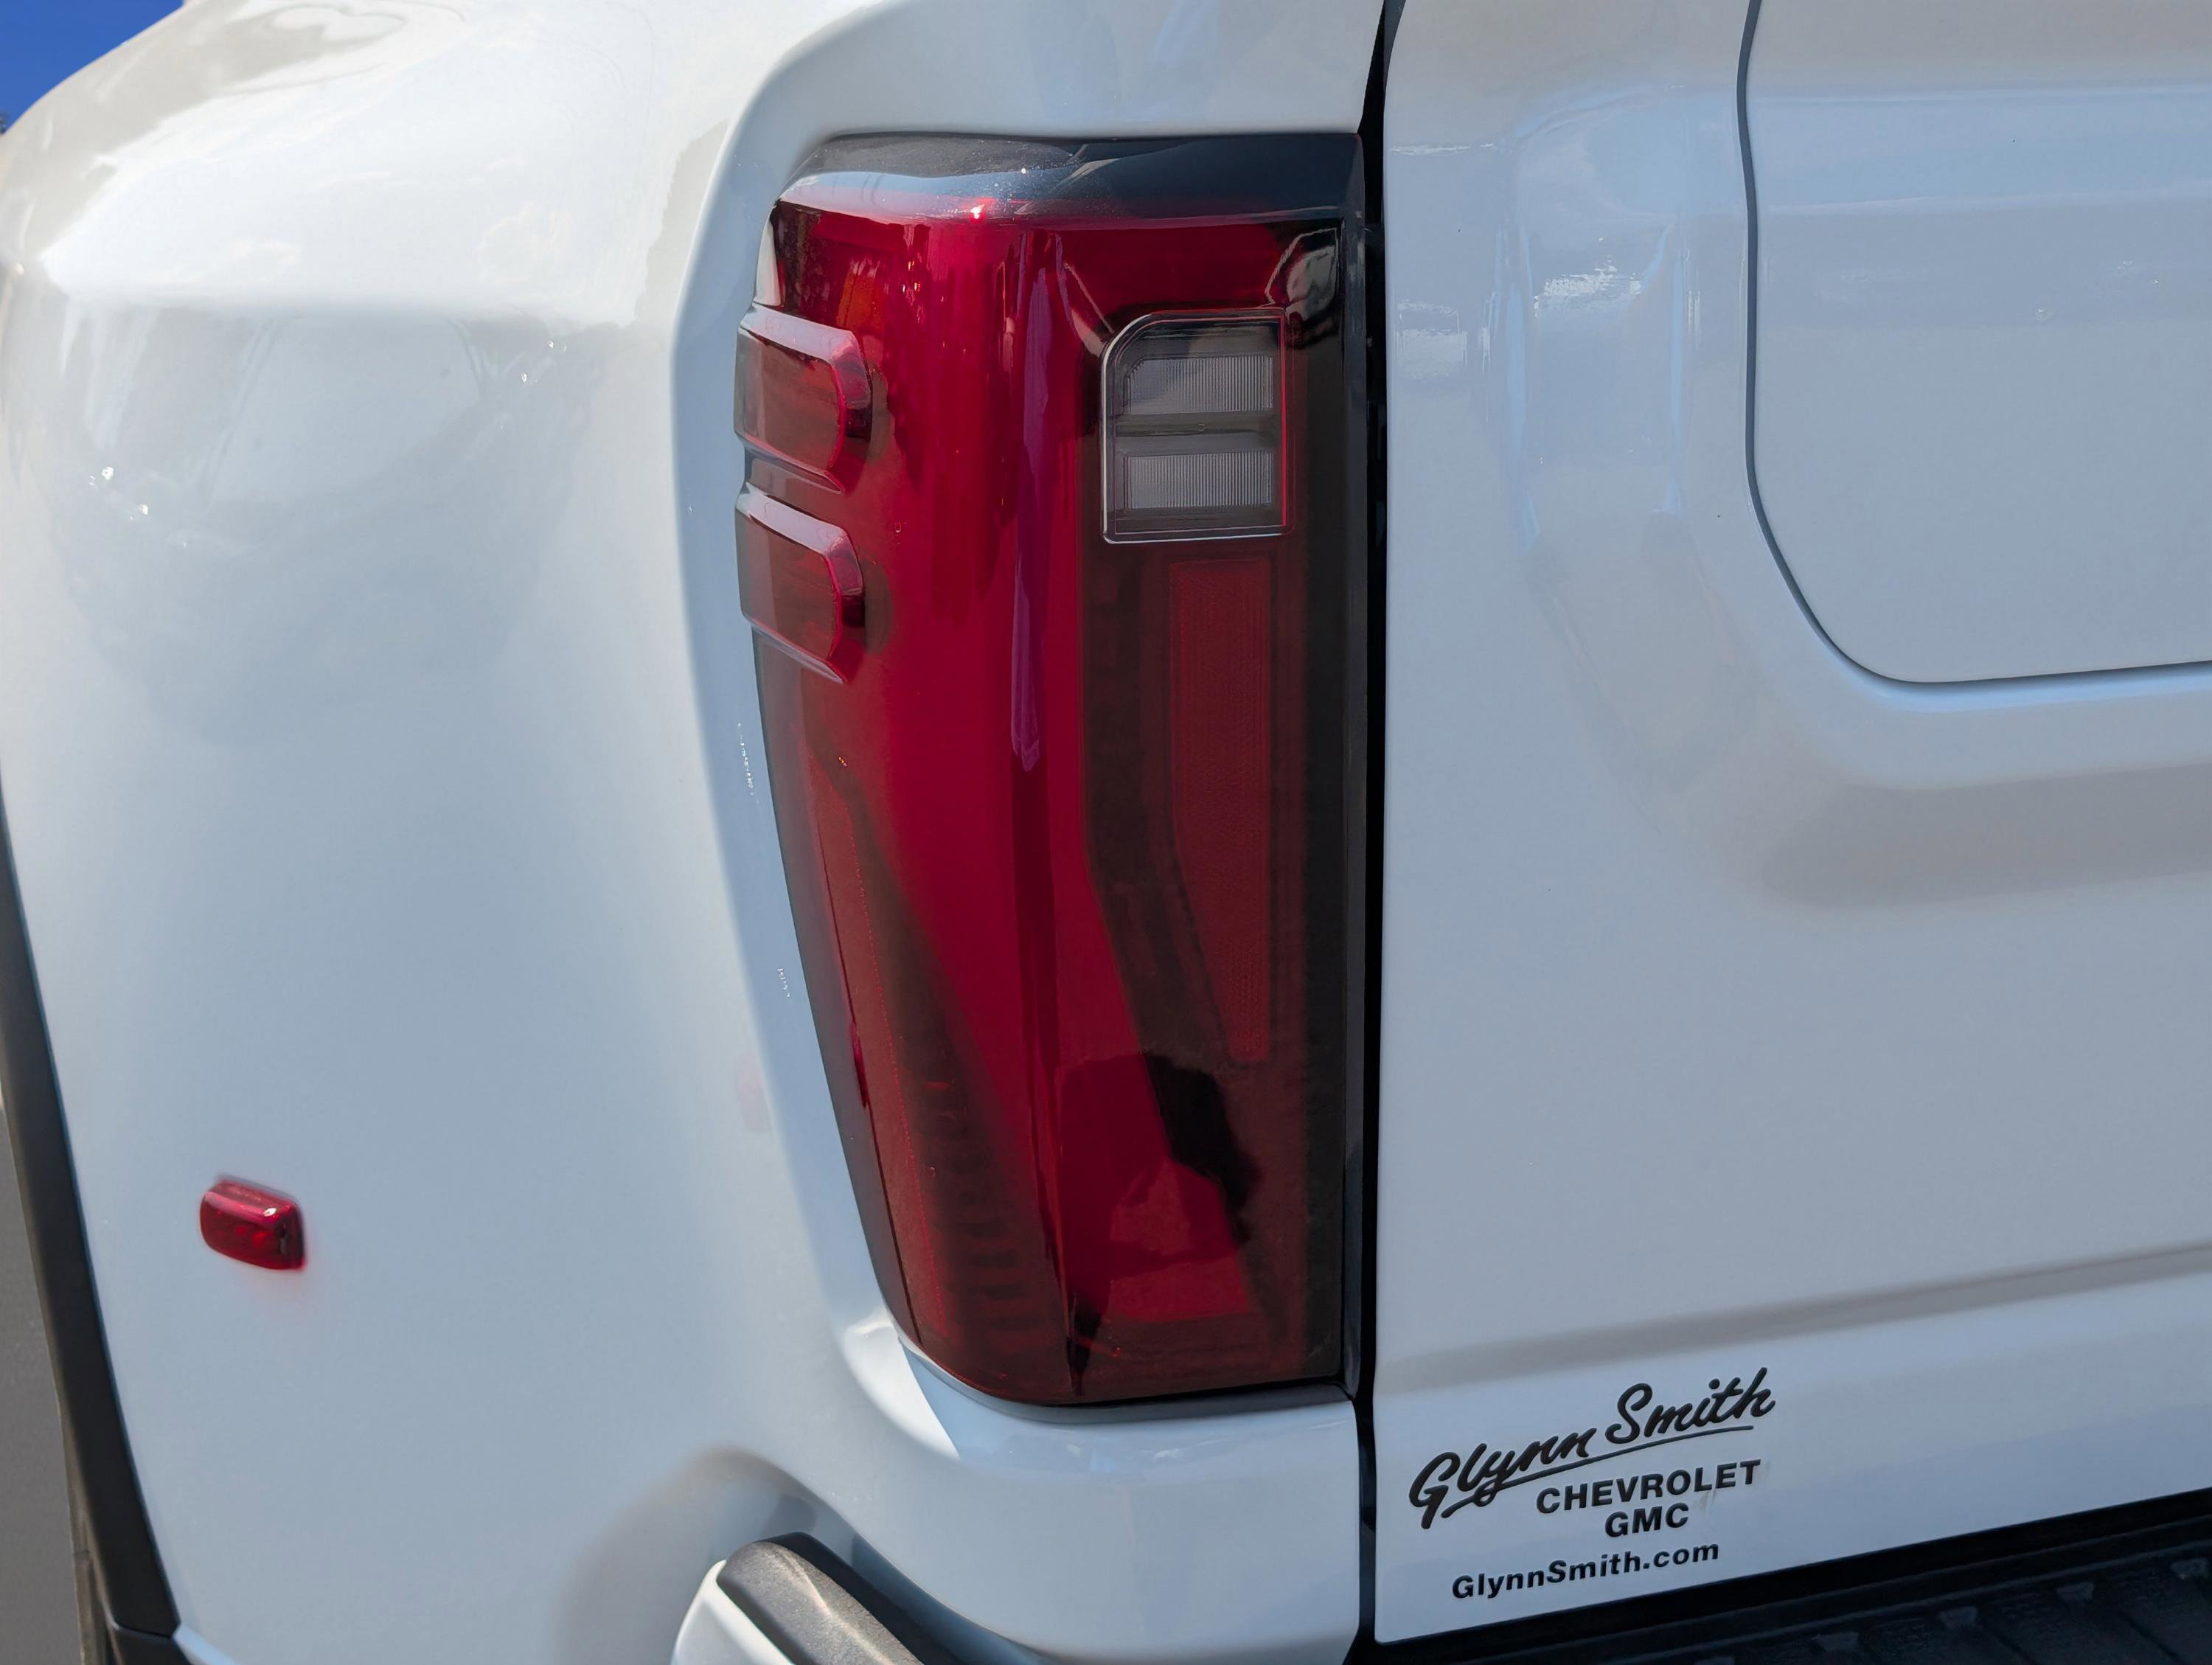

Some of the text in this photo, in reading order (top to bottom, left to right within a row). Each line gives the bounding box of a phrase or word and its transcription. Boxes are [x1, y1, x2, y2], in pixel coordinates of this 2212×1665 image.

[1408, 1366, 1777, 1530] Glynn Smith
[1536, 1459, 1761, 1515] CHEVROLET
[1604, 1502, 1690, 1538] GMC
[1451, 1543, 1719, 1600] GlynnSmith.com
